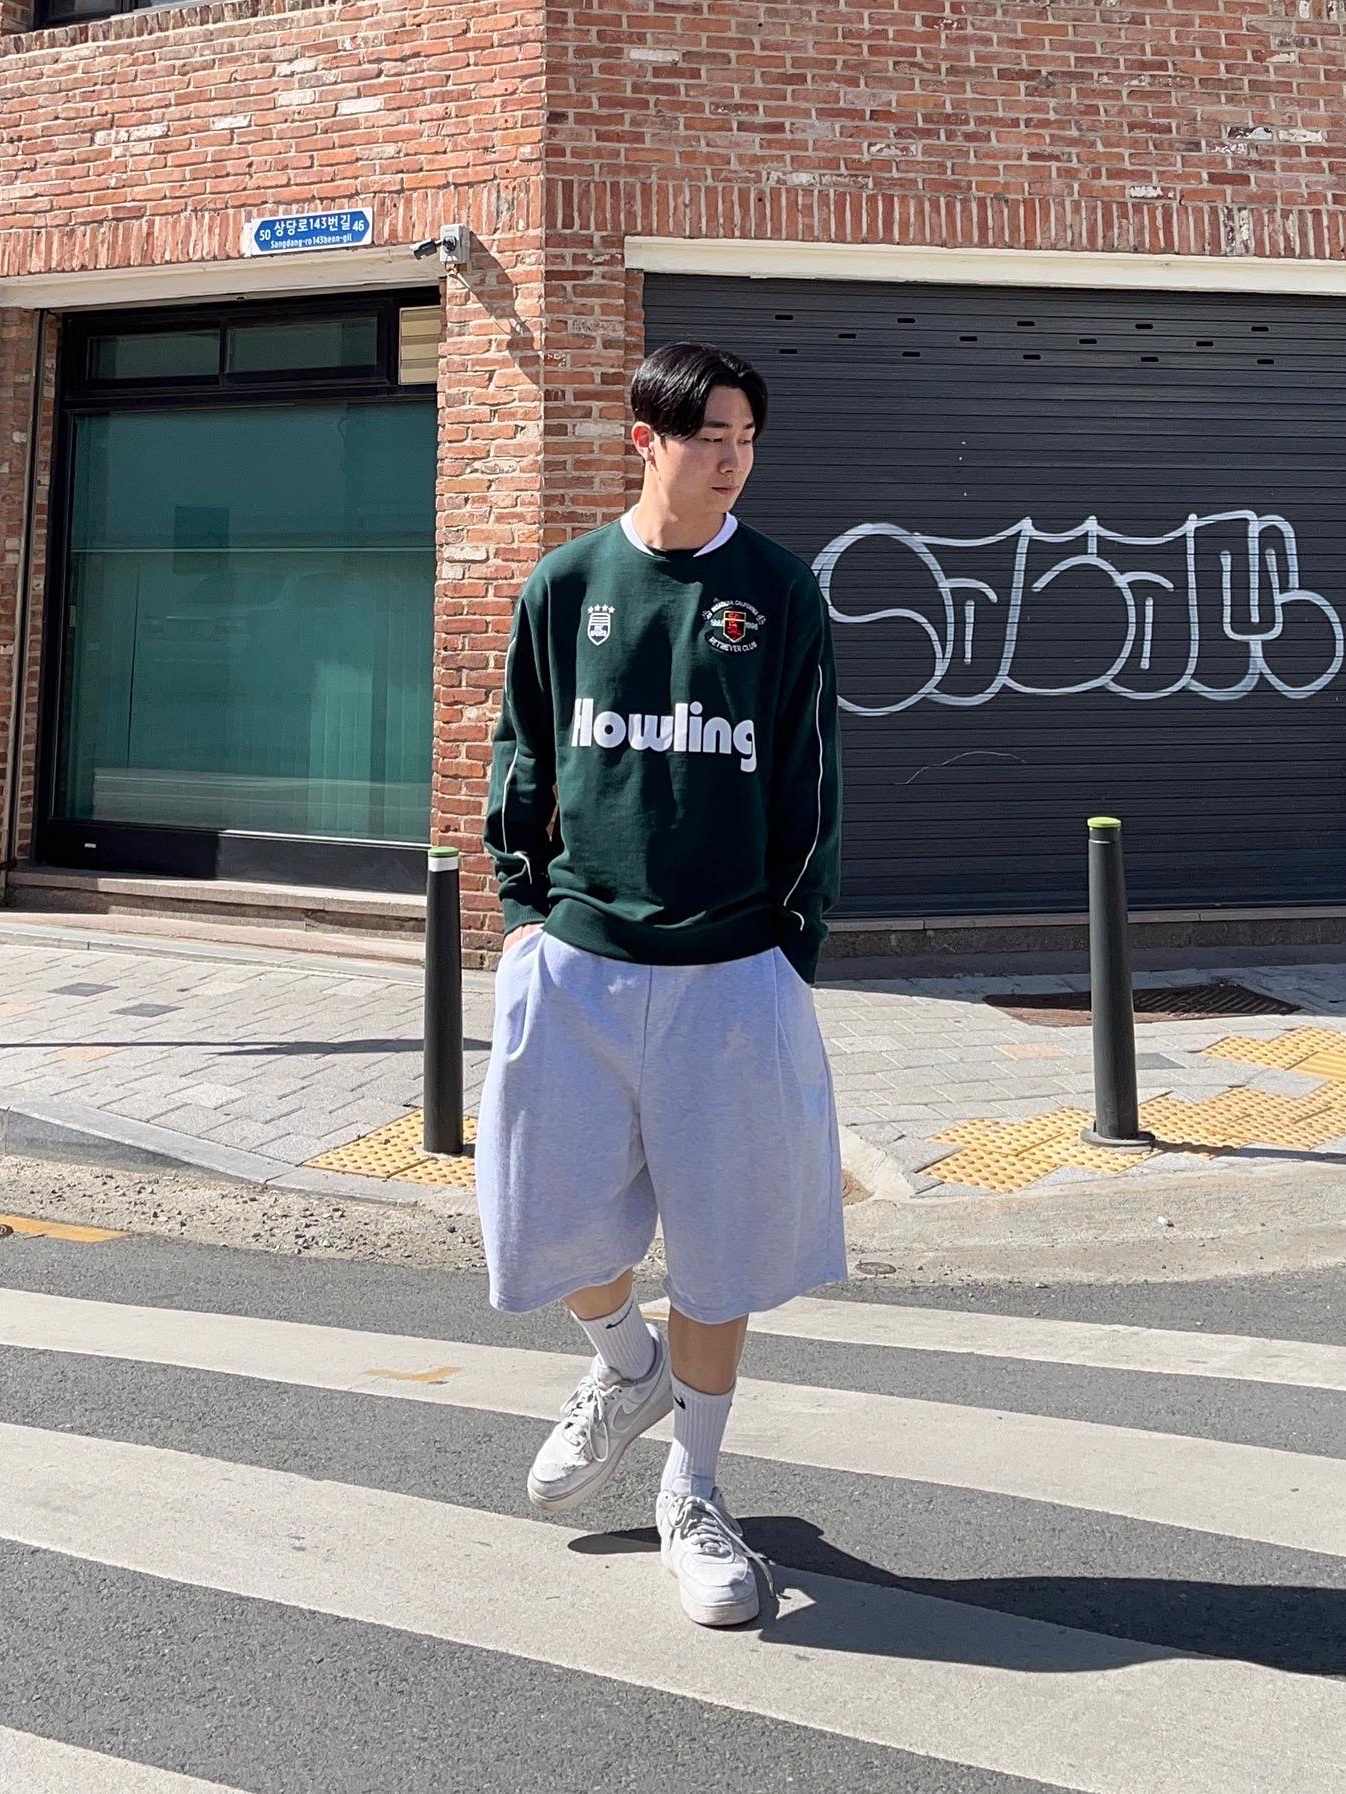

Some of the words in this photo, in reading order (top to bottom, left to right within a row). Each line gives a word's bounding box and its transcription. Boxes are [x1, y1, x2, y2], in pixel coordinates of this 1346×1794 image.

[259, 229, 271, 241] 50
[273, 214, 351, 237] 상당로143번길
[352, 219, 365, 232] 46
[742, 641, 758, 652] CLUB
[571, 698, 758, 773] Howling
